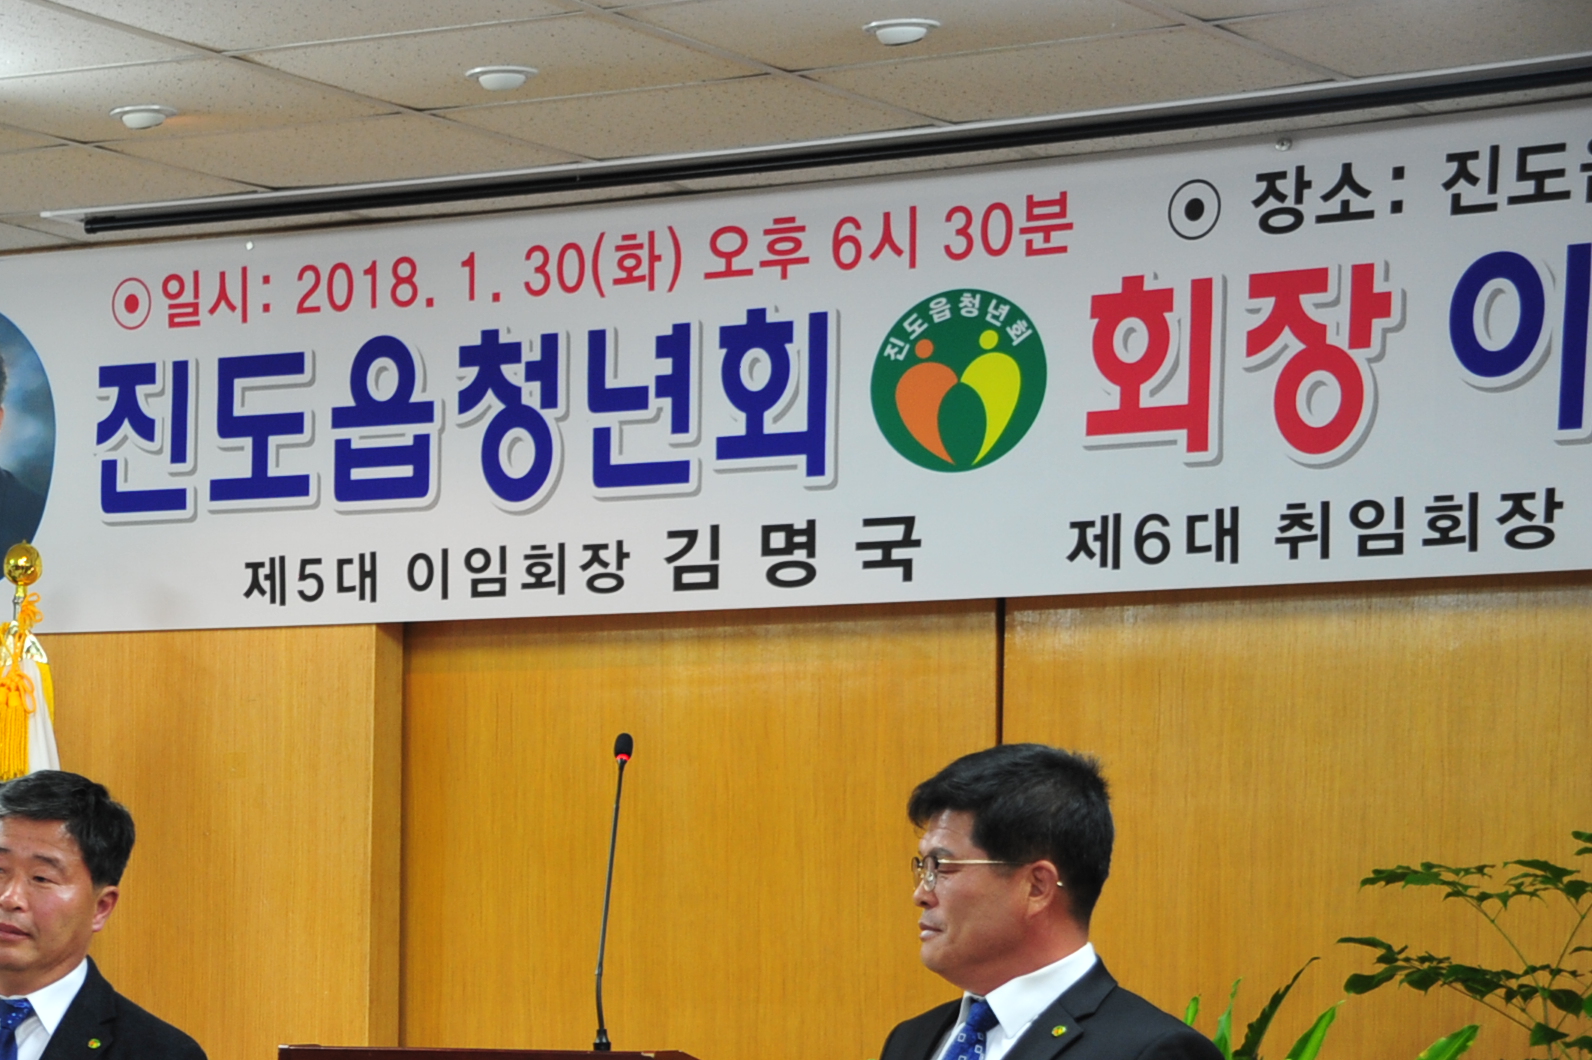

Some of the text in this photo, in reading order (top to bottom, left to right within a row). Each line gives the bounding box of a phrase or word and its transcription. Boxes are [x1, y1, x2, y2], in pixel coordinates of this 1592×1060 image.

[1250, 161, 1407, 236] 장소:
[161, 190, 1075, 329] 일시: 2018. 1. 30(화) 오후 6시 30분
[883, 292, 1034, 362] 진도읍청년회
[94, 306, 834, 518] 진도읍청년회
[1085, 261, 1394, 456] 회장
[1065, 487, 1565, 571] 제6대 취임회장
[242, 550, 379, 607] 제5대
[407, 538, 631, 601] 이임회장
